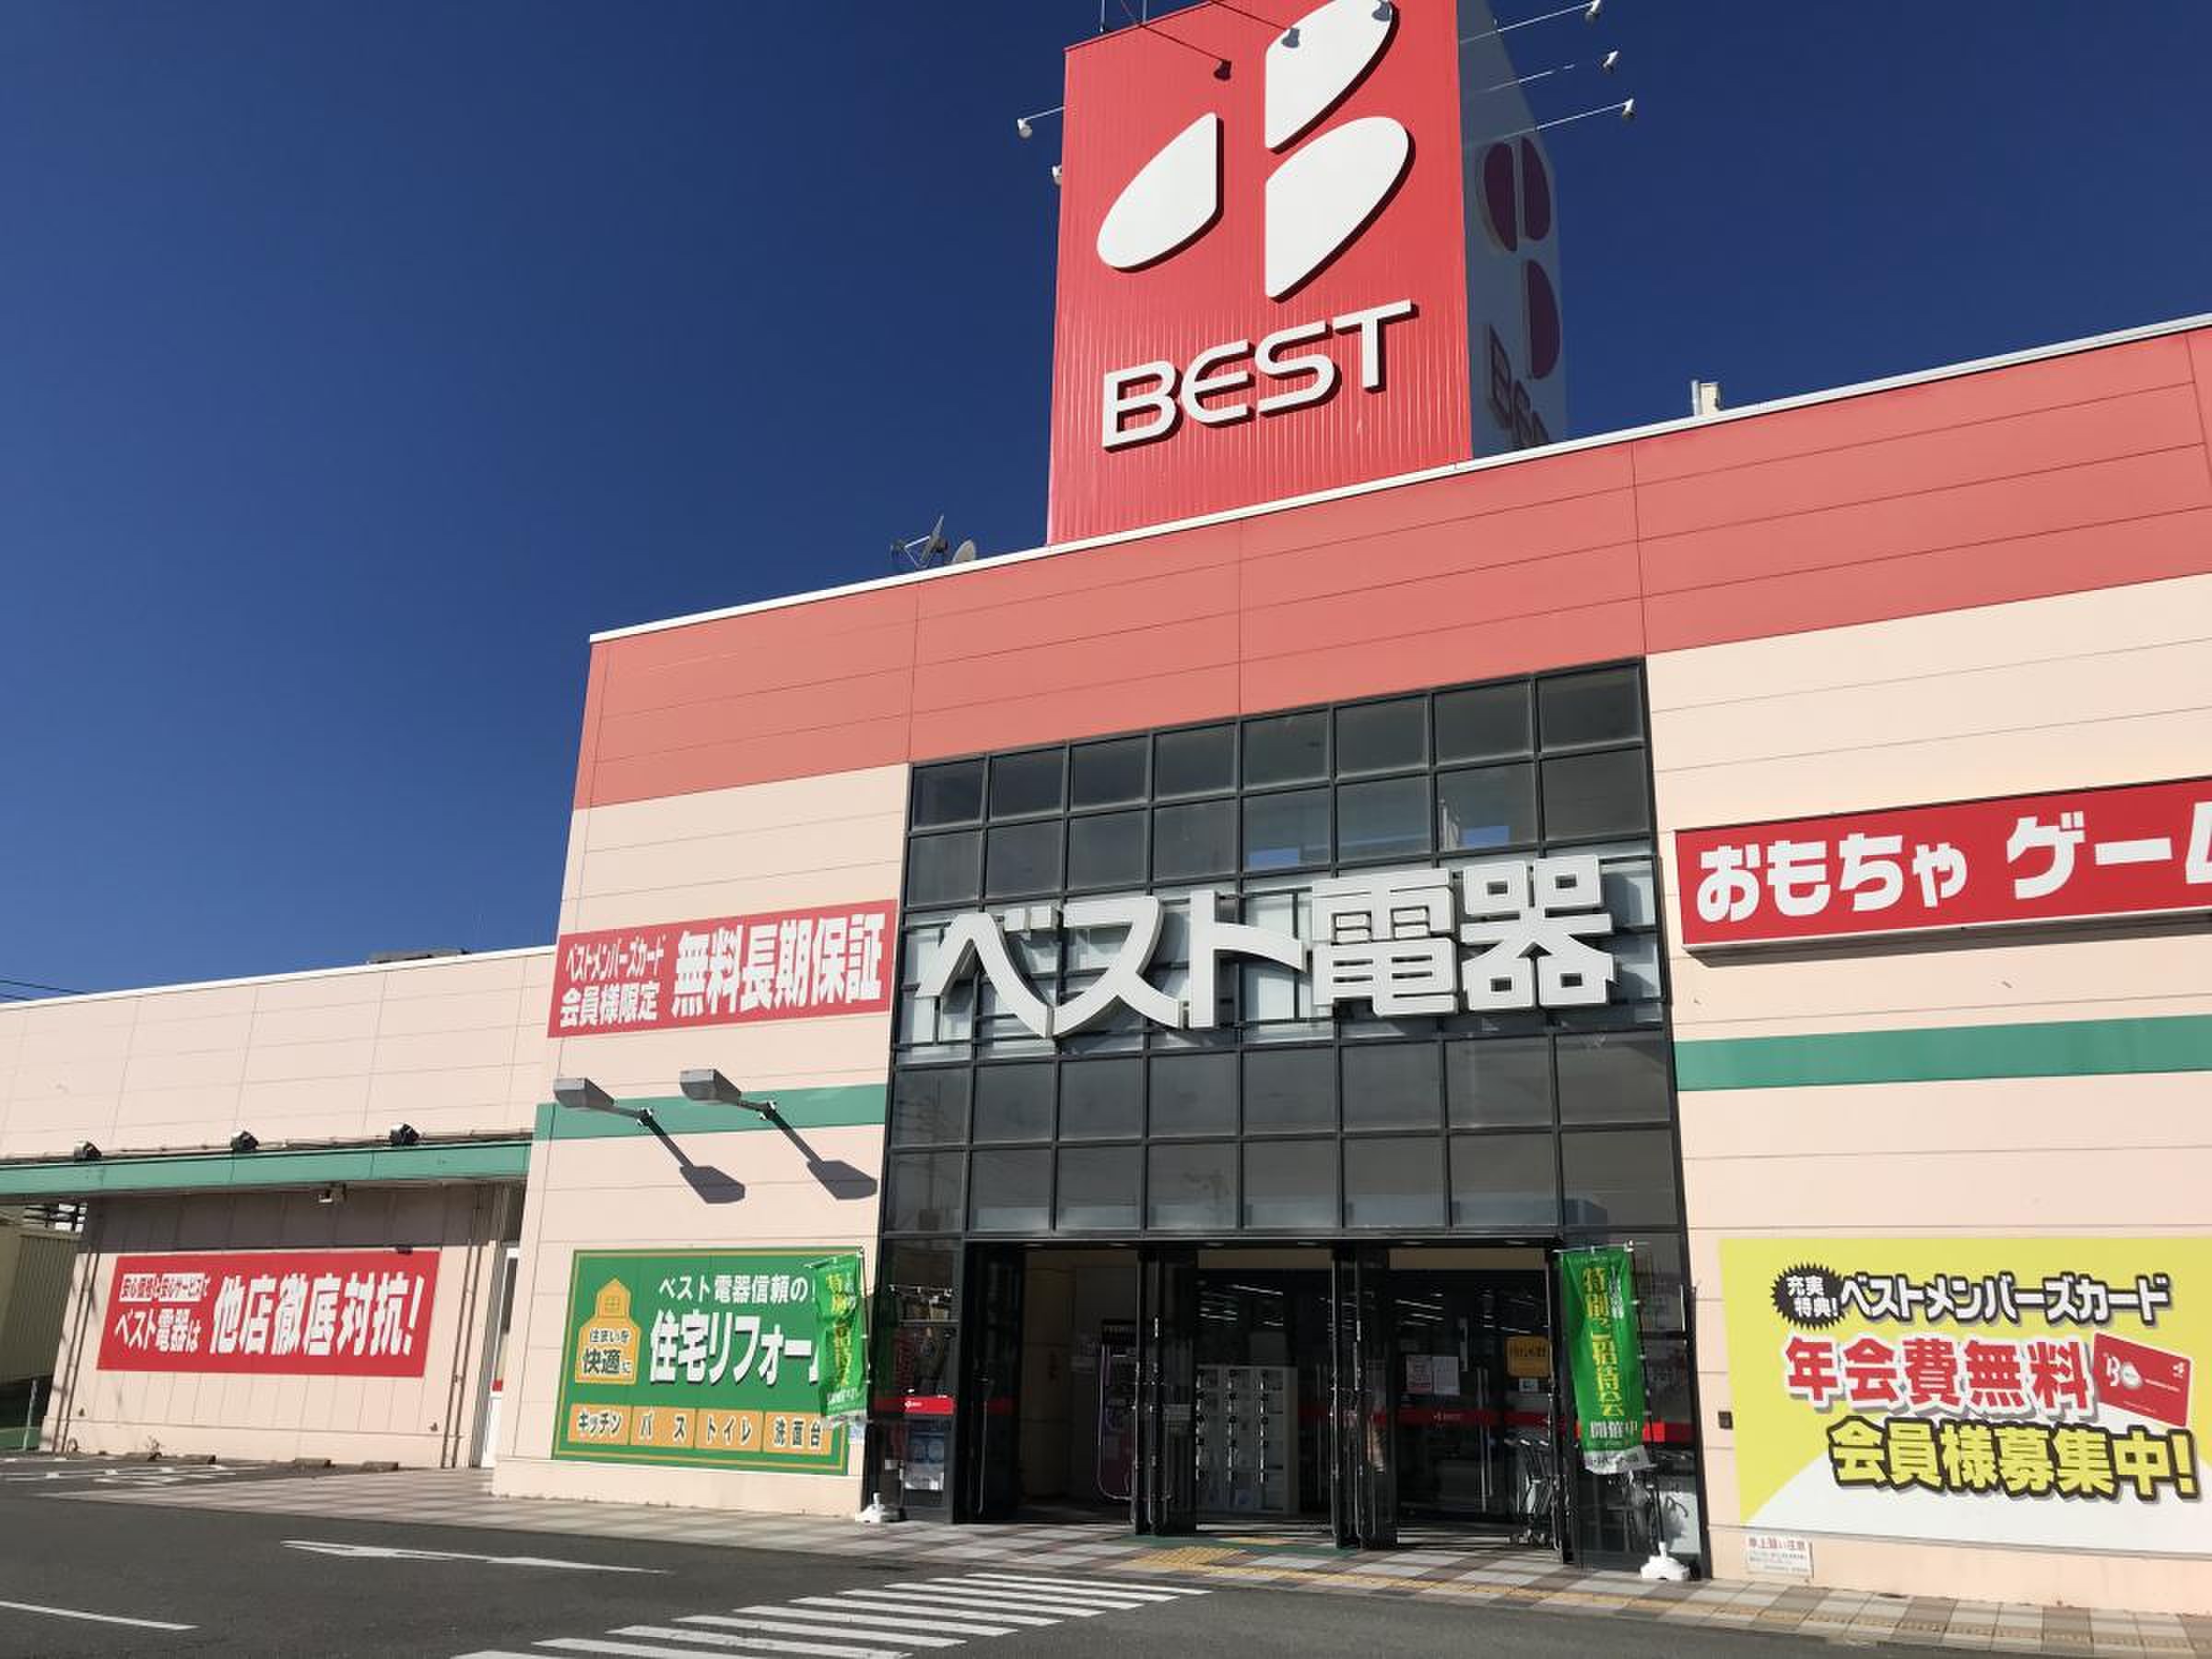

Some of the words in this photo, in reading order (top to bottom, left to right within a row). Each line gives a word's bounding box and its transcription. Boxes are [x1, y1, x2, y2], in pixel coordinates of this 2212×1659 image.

[1102, 300, 1415, 449] BEST
[1696, 832, 1969, 923] おもちゃ
[565, 935, 665, 982] ベストメンバーズカード
[671, 912, 887, 1018] 無料長期保証
[915, 854, 1618, 1039] ベスト電器
[559, 980, 661, 1029] 会員様限定
[659, 1275, 816, 1304] ベスト電器信頼の
[1785, 1275, 1825, 1298] 充実
[1840, 1271, 2171, 1324] ベストメンバーズカード
[582, 1347, 631, 1374] 快適に
[1784, 1335, 2091, 1412] 年会費無料
[578, 1411, 623, 1435] キッチン
[706, 1414, 753, 1443] トイレ
